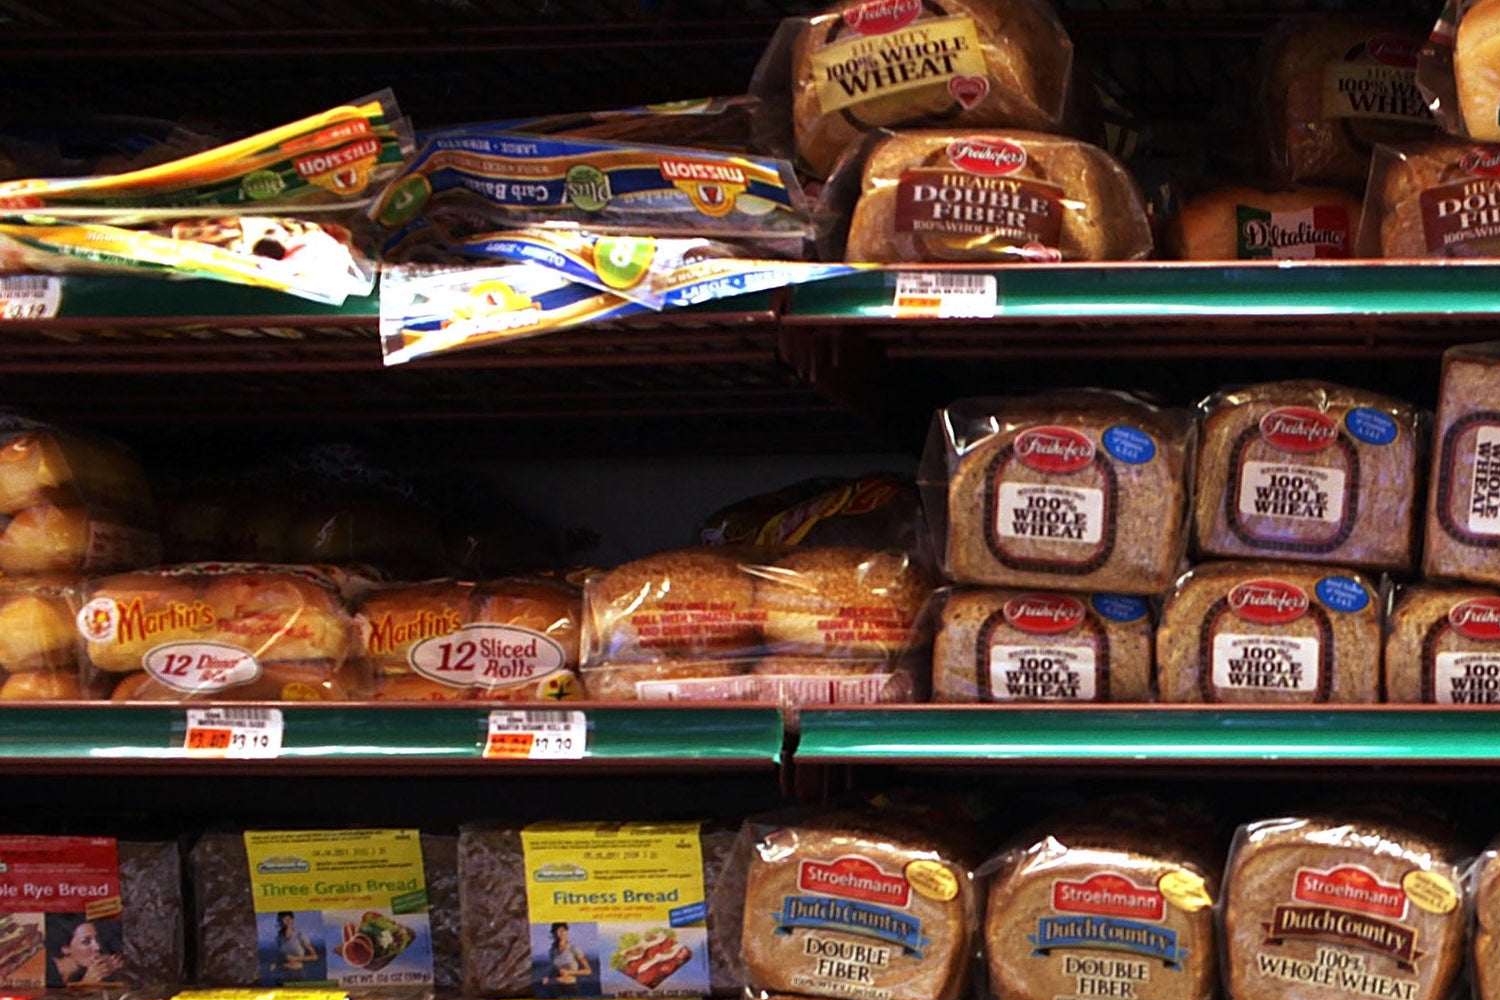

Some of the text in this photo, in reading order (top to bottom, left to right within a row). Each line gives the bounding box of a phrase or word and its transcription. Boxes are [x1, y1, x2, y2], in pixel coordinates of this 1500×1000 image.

[852, 29, 930, 57] HEARTY
[826, 35, 969, 82] 100% WHOLE
[839, 53, 959, 98] WHEAT
[943, 174, 1021, 191] HEARTY
[912, 185, 1049, 218] DOUBLE
[932, 203, 1027, 229] FIBER
[1472, 441, 1492, 517] WHEAT
[116, 599, 215, 642] Martin's
[368, 608, 461, 655] Martin's
[161, 654, 191, 677] 12
[436, 637, 537, 671] 12 Sliced
[480, 656, 535, 680] Rolls
[23, 884, 109, 898] Rye Bread
[260, 878, 418, 896] Three Grain Bread
[807, 866, 903, 895] Stroehmann
[1303, 877, 1399, 907] Stroehmann
[552, 889, 679, 905] Fitness Bread
[804, 938, 888, 966] DOUBLE
[1317, 950, 1364, 971] 100%
[815, 959, 871, 983] FIBER
[1259, 956, 1335, 985] WHOLE
